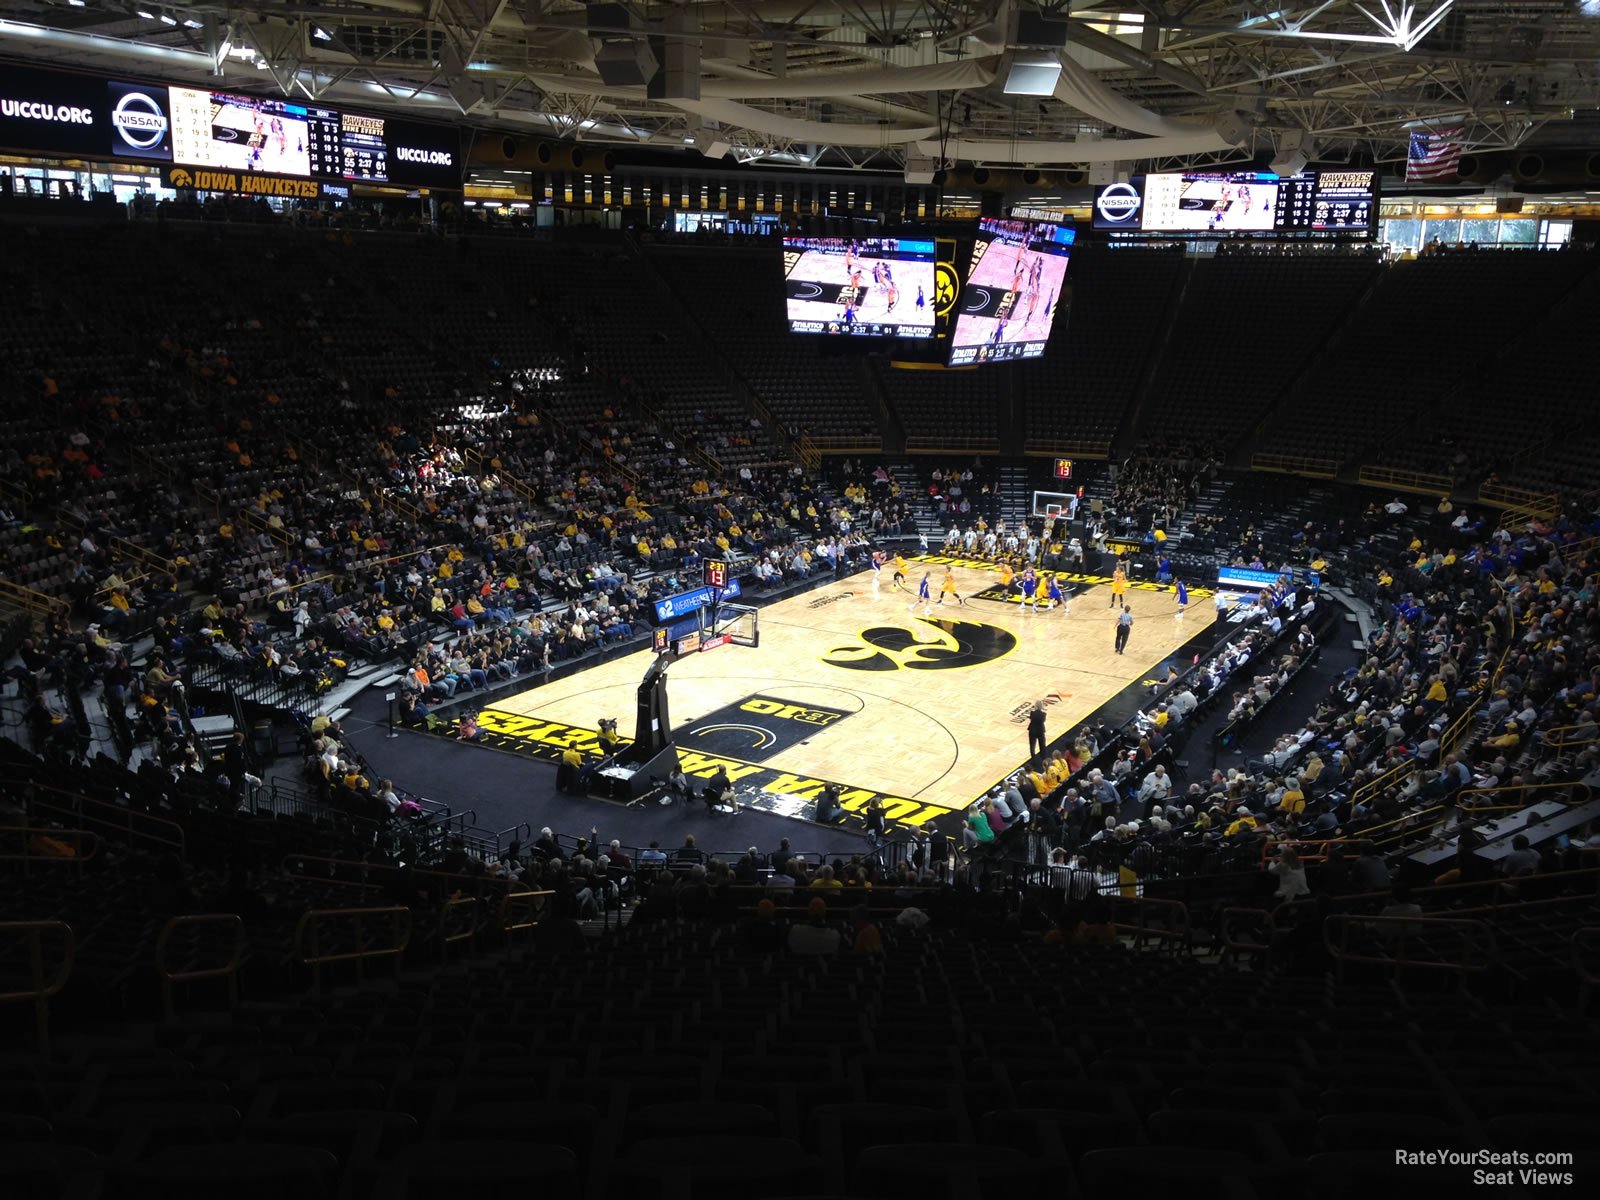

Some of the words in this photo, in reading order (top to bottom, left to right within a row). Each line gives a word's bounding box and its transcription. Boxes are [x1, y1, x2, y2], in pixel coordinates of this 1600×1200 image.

[1, 99, 93, 125] UICCU.ORG
[118, 114, 163, 128] NISSAN
[342, 115, 385, 129] HAWKEYES
[323, 134, 331, 142] 10
[396, 146, 452, 166] UICCU.ORG
[344, 157, 356, 168] 55
[358, 158, 373, 168] 2:37
[375, 160, 386, 171] 61
[1319, 172, 1374, 182] HAWKEYES
[194, 171, 237, 191] IOWA
[241, 175, 318, 198] HAWKEYES
[1315, 210, 1328, 219] 55
[1333, 209, 1351, 218] 2:37
[1354, 209, 1367, 219] 61
[995, 348, 1006, 358] 2:37
[1060, 466, 1070, 476] 13
[709, 561, 725, 571] 2:37
[711, 570, 723, 585] 13
[664, 600, 674, 618] 2
